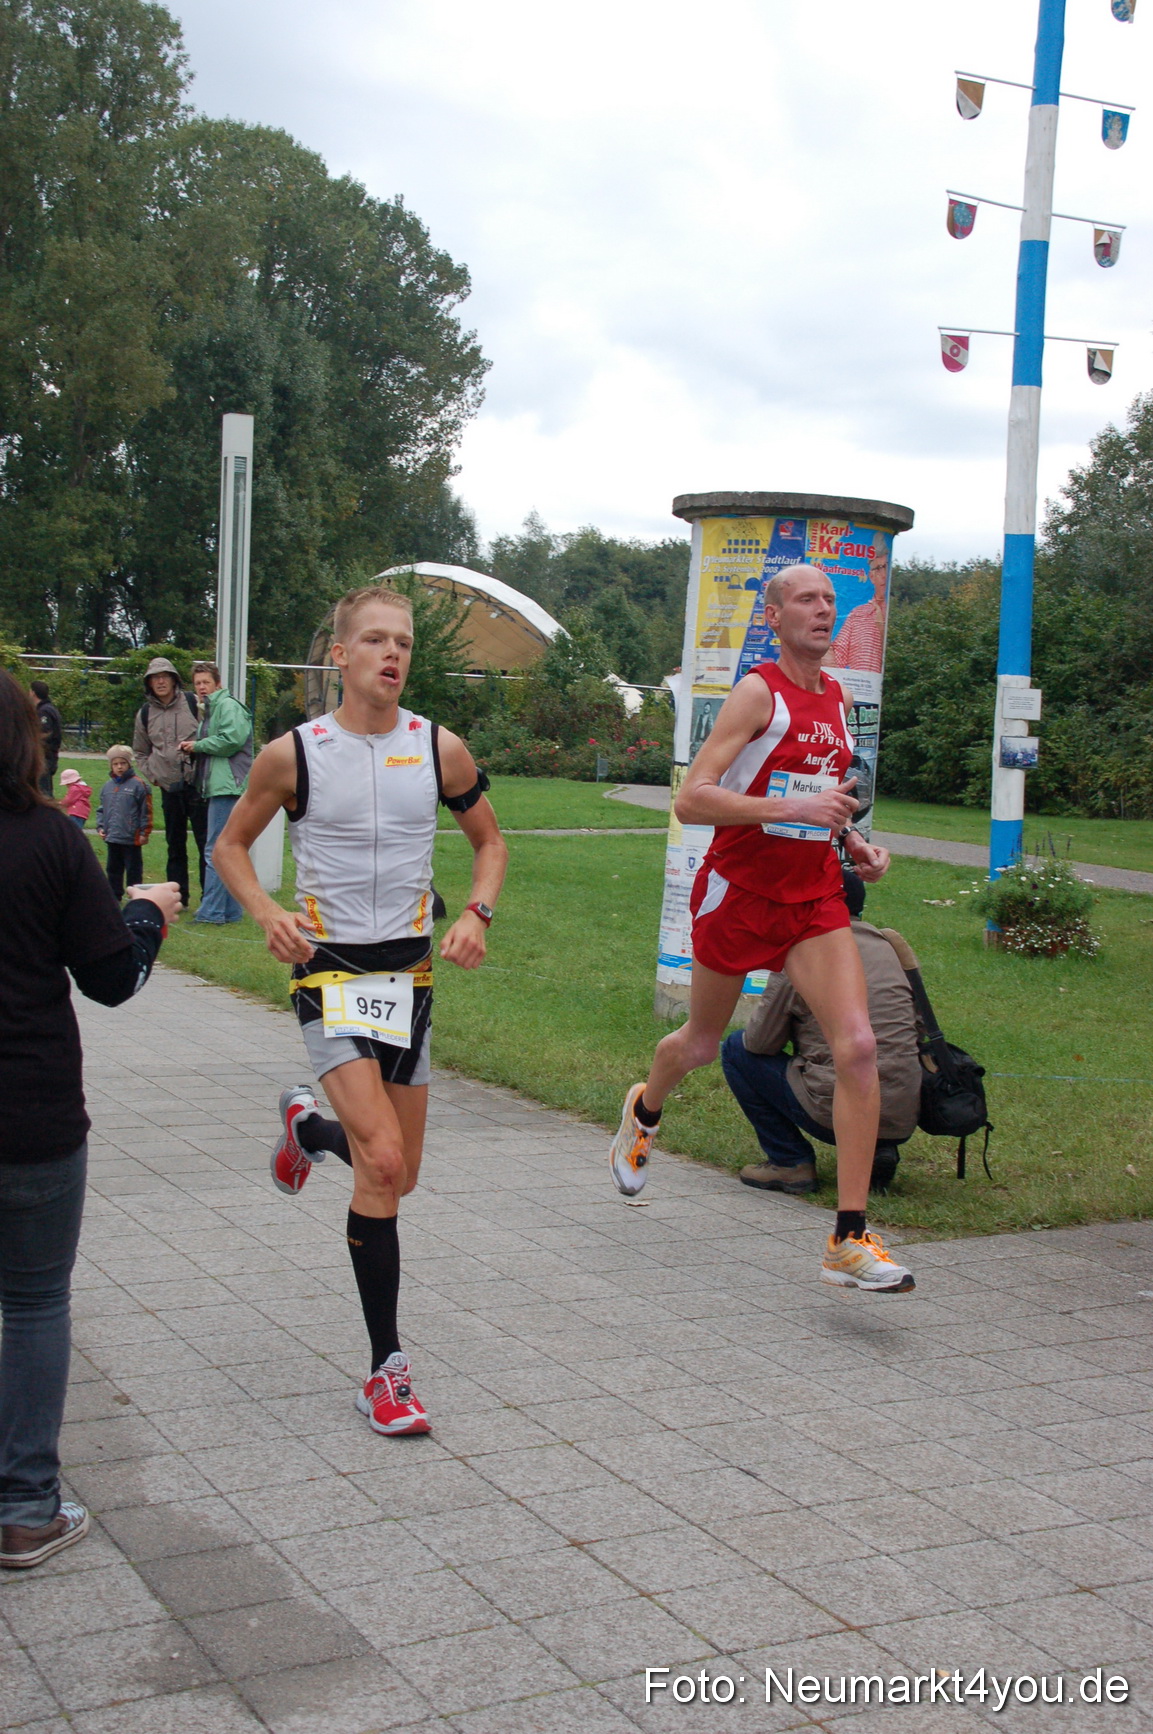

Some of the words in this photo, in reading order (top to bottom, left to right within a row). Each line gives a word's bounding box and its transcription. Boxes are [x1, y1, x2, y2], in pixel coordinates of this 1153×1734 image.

[820, 522, 854, 537] Karl-
[818, 535, 876, 559] Kraus
[757, 554, 802, 565] Stadtlauf
[760, 566, 779, 574] 2008
[813, 721, 837, 739] DJK
[387, 756, 420, 765] PowerBar
[792, 779, 822, 794] Markus
[356, 997, 397, 1021] 957
